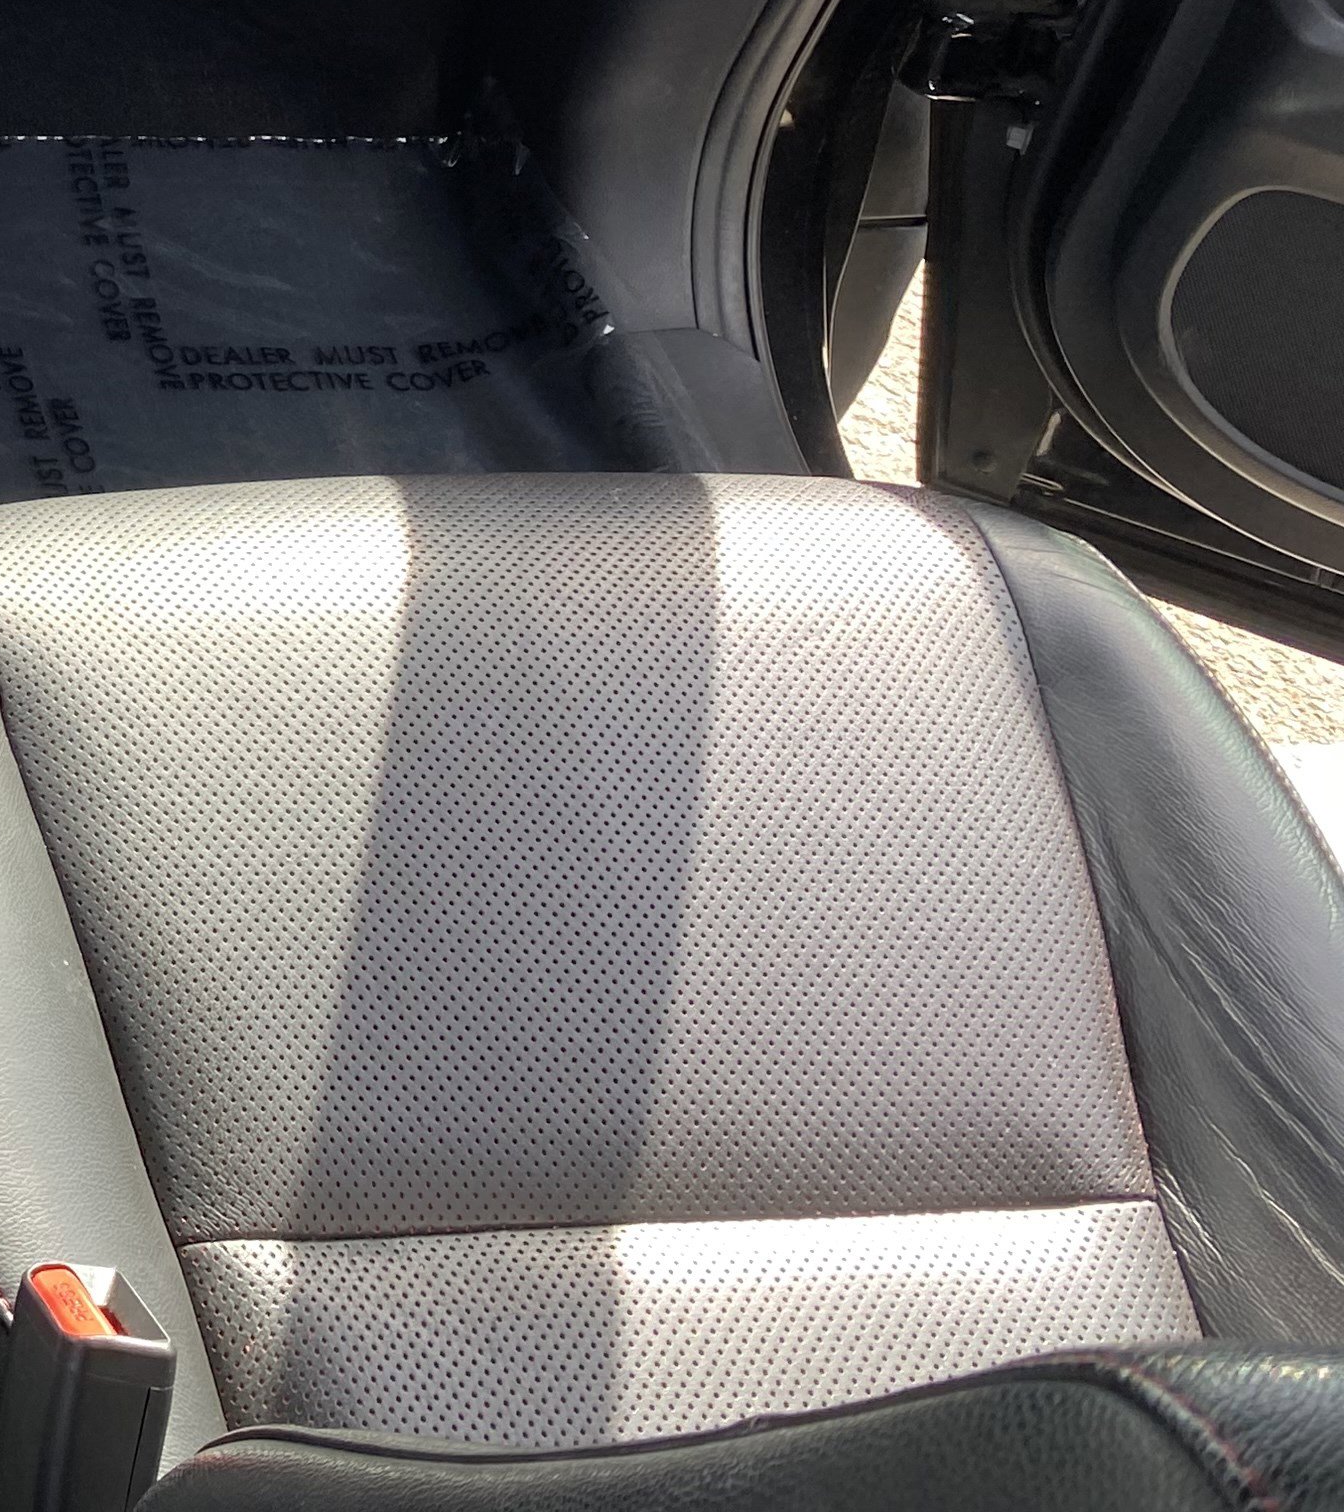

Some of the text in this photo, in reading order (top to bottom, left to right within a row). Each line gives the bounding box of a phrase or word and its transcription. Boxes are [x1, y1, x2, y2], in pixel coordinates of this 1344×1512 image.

[88, 259, 132, 343] COVER
[179, 343, 295, 366] DEALER
[314, 345, 400, 367] MUST
[186, 359, 491, 392] PROTECTIVE COVER
[50, 396, 95, 473] COVER
